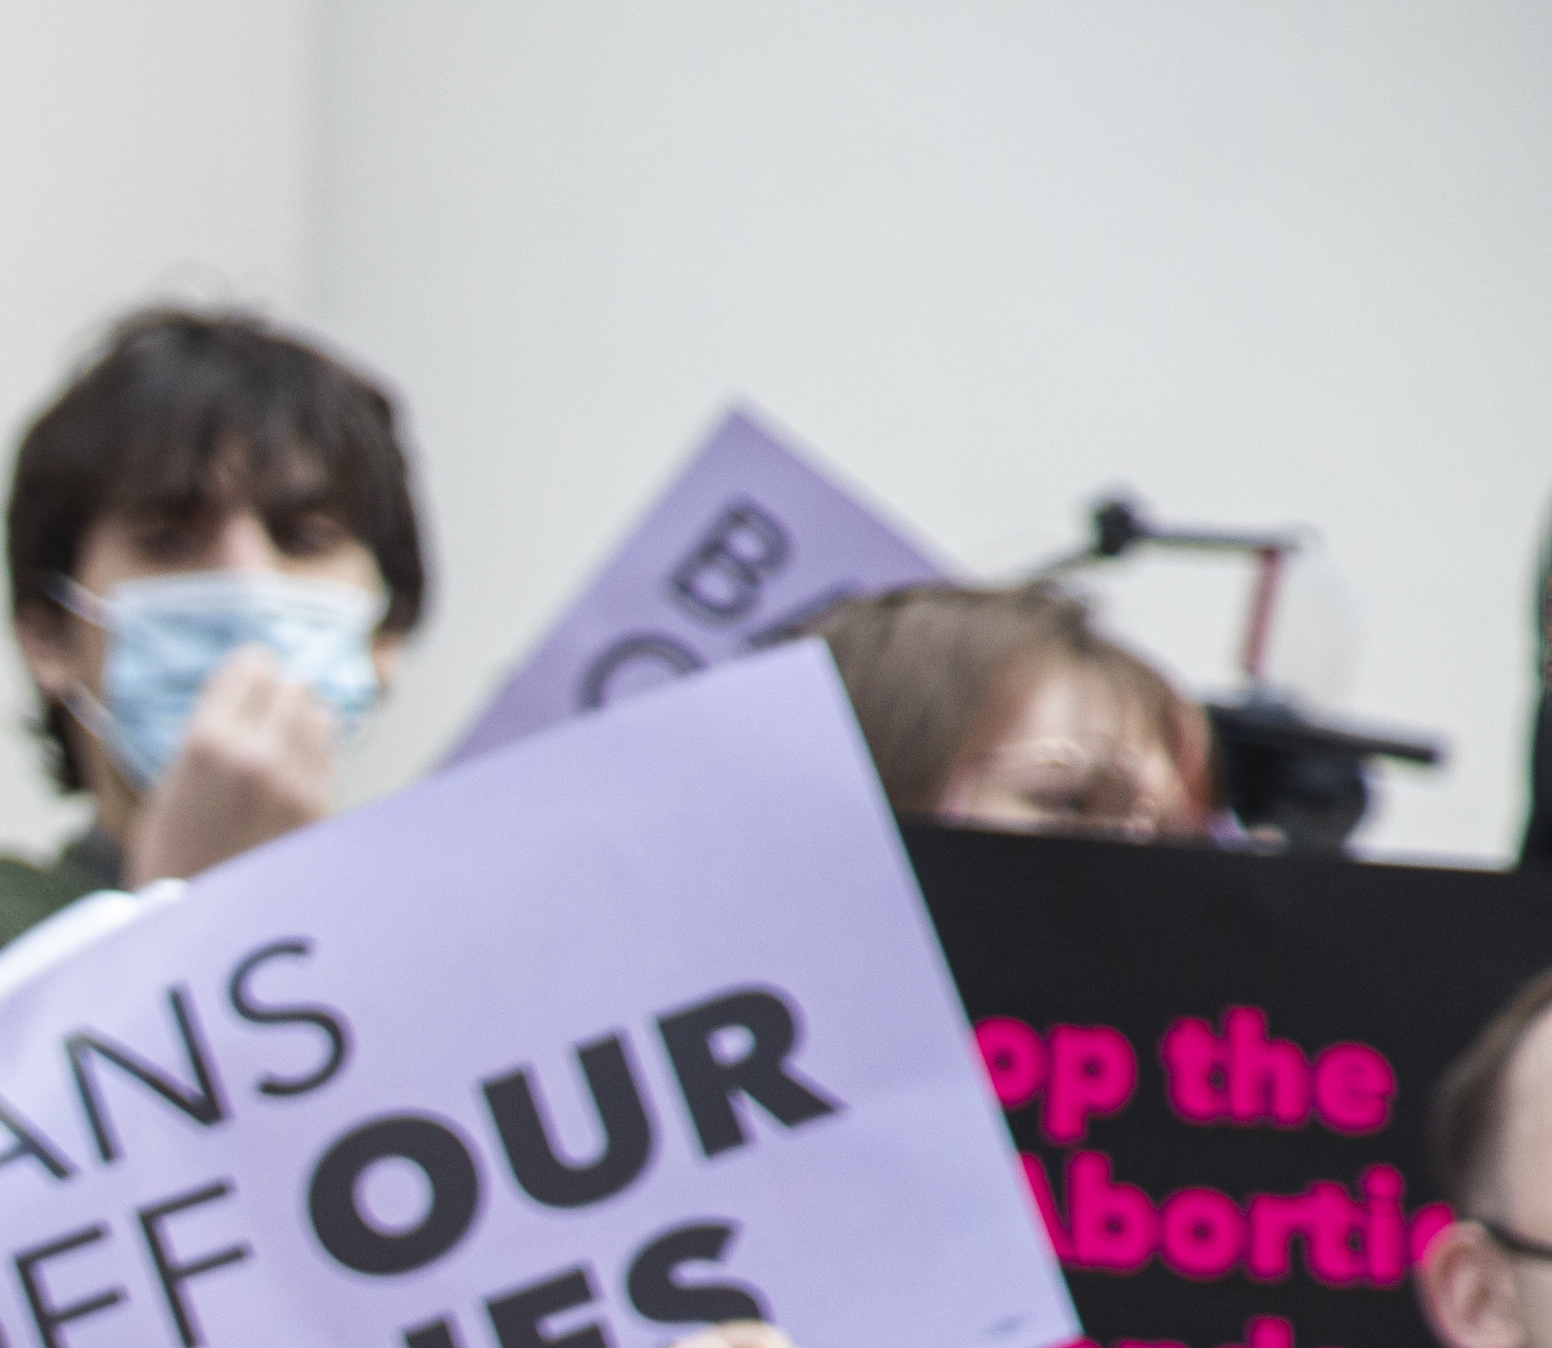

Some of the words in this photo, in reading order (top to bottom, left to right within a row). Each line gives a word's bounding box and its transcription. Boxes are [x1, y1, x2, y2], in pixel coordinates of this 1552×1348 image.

[306, 982, 850, 1278] OUR
[1160, 1006, 1397, 1133] the
[1020, 1148, 1457, 1286] borti
